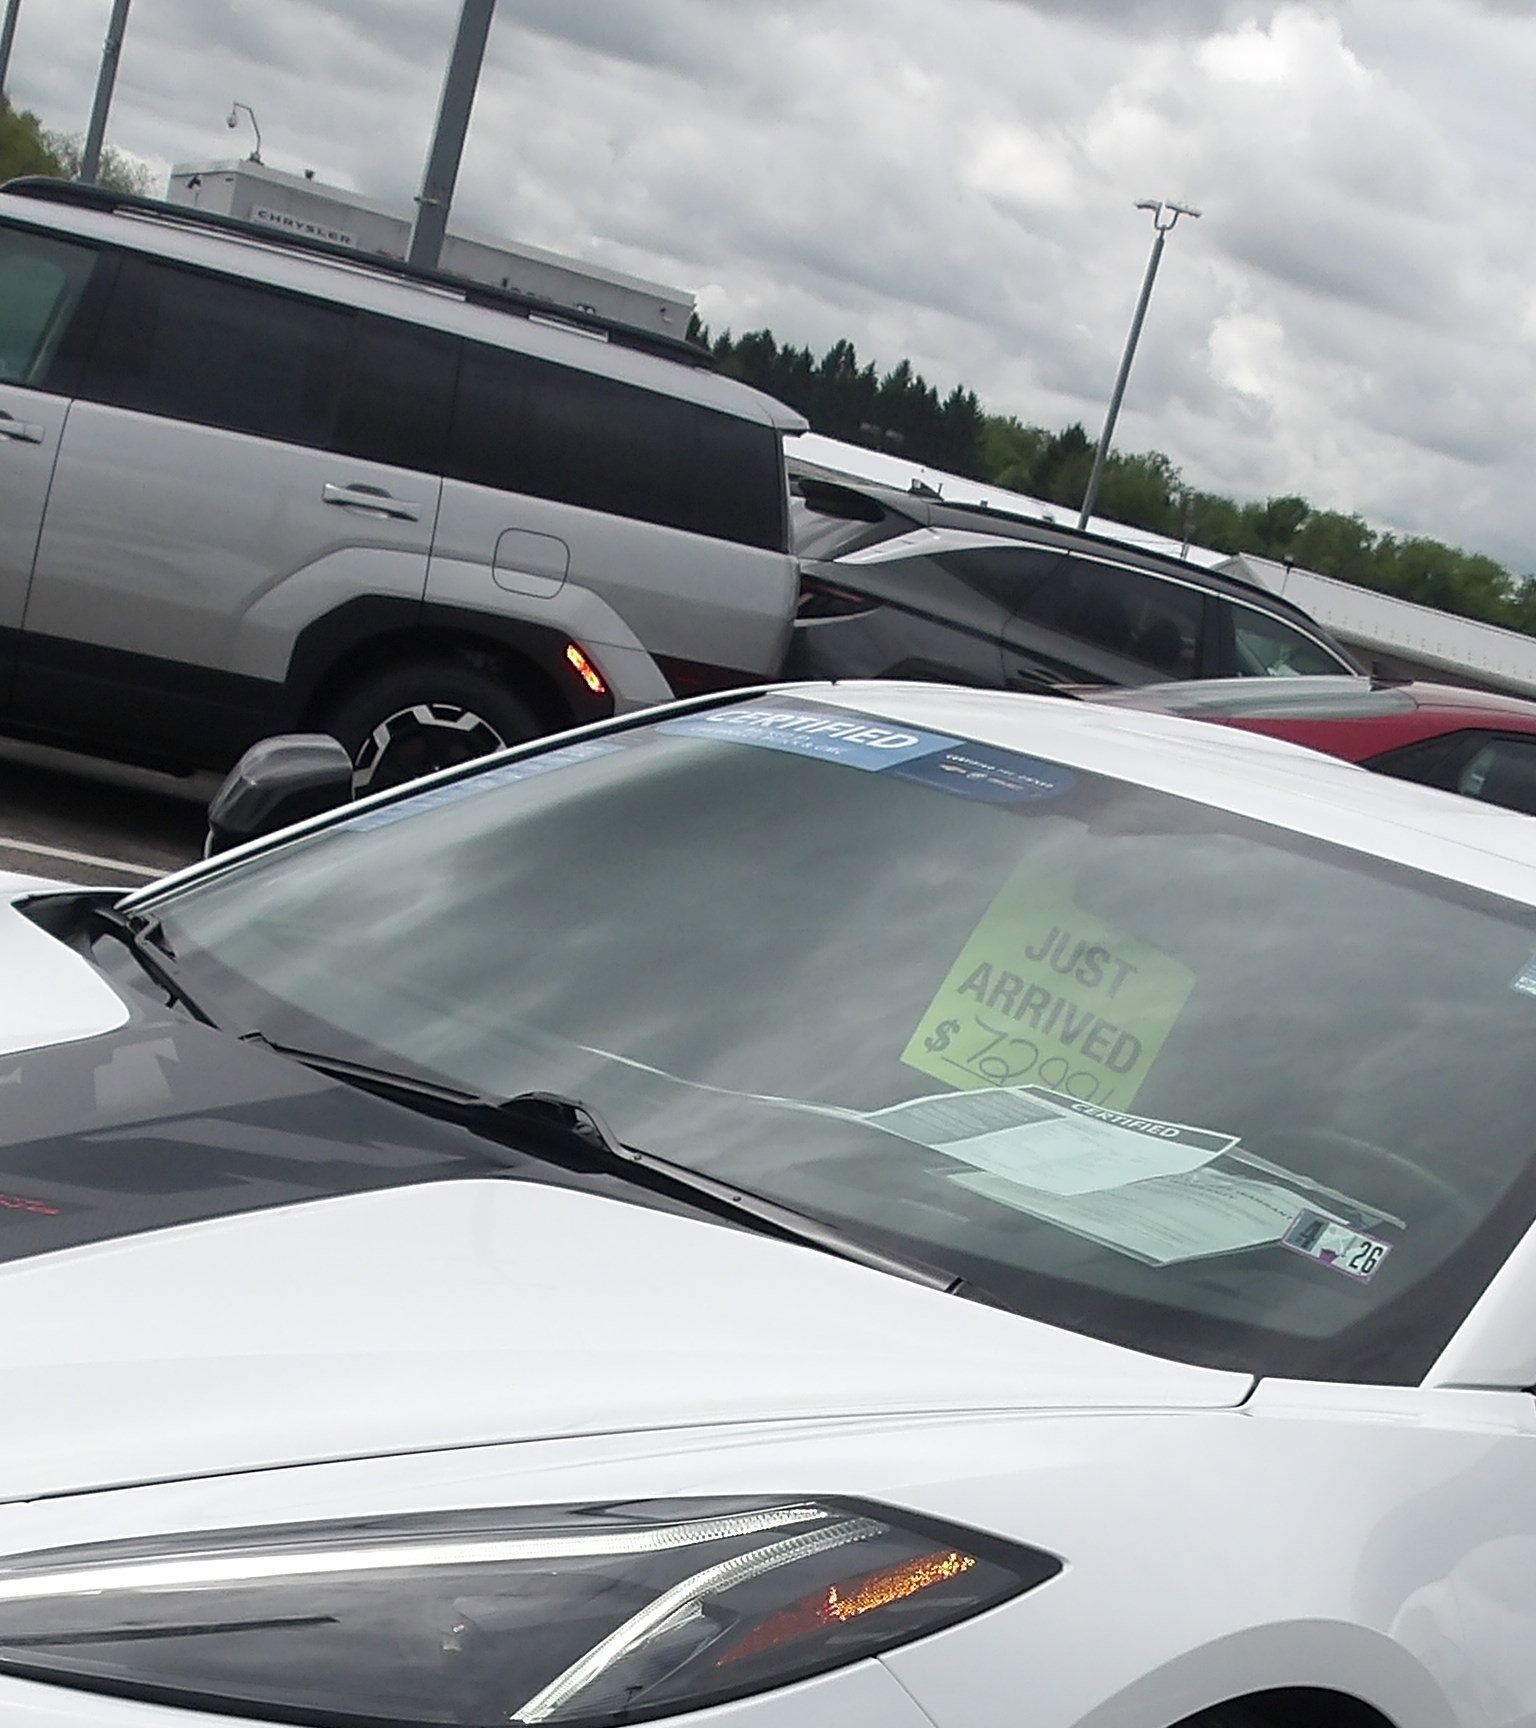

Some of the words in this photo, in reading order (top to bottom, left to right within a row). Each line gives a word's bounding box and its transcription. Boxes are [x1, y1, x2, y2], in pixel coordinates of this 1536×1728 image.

[257, 210, 351, 244] CHRYSLER
[705, 710, 921, 750] CERTIFIED
[1024, 926, 1138, 999] JUST
[955, 962, 1143, 1074] ARRIVED
[1071, 1102, 1181, 1138] CERTIFIED
[1349, 1241, 1384, 1274] 26
